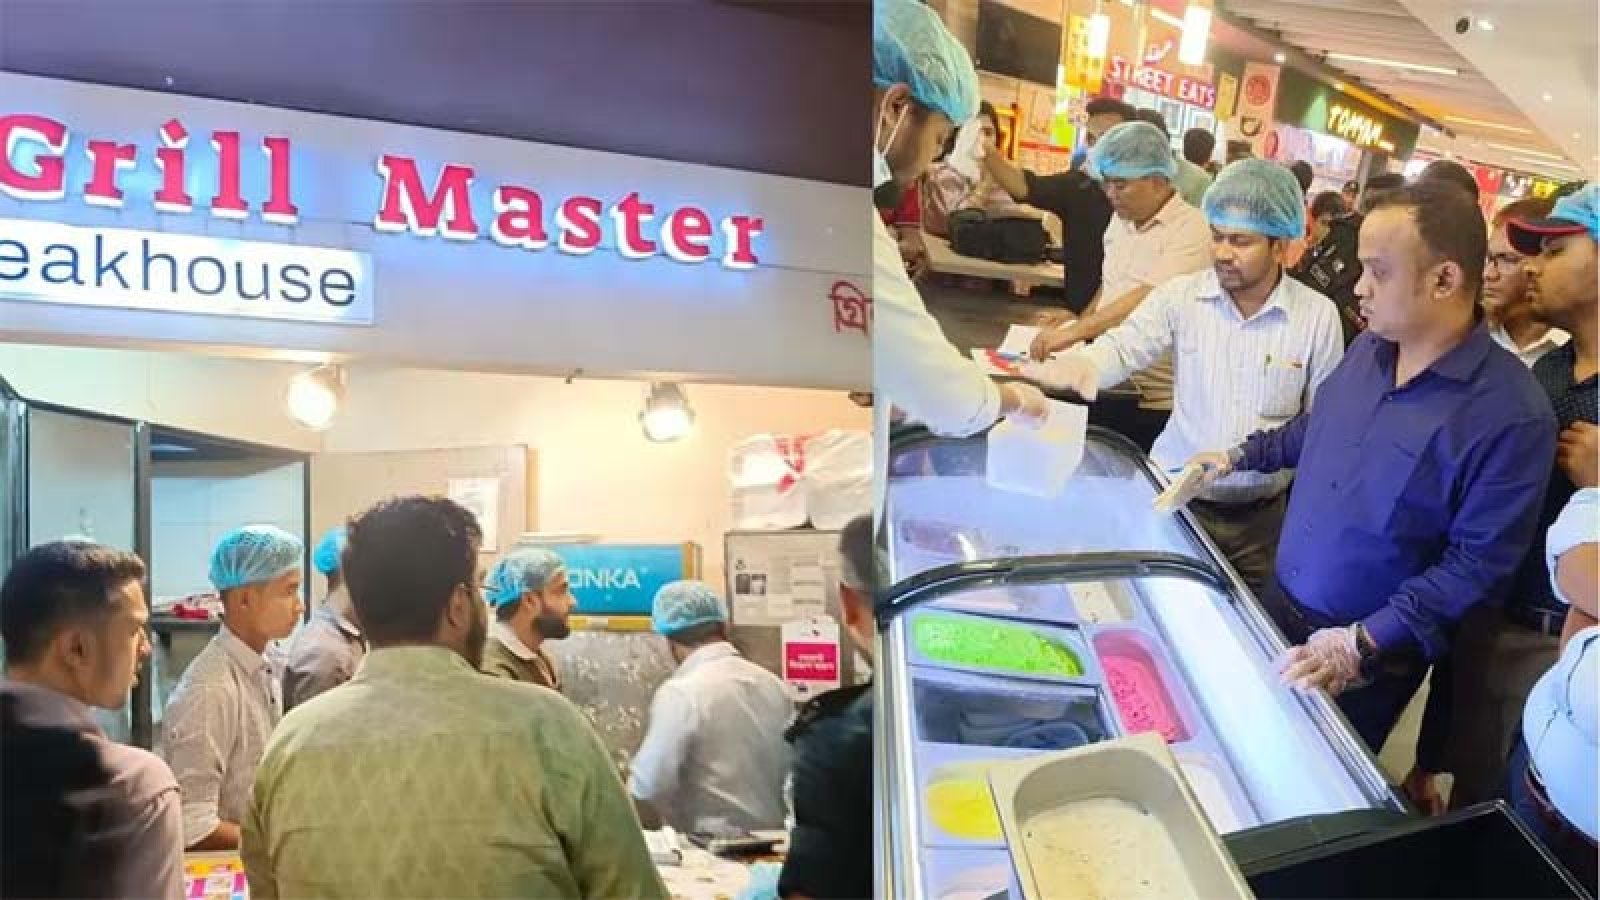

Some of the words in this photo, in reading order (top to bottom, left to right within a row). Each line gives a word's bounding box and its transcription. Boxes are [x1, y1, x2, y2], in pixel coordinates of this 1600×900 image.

[1106, 55, 1174, 95] STREET
[1178, 77, 1215, 107] EATS
[0, 113, 298, 221] Grill
[374, 154, 764, 267] Master
[0, 233, 356, 307] eakhouse
[566, 567, 641, 588] ONKA
